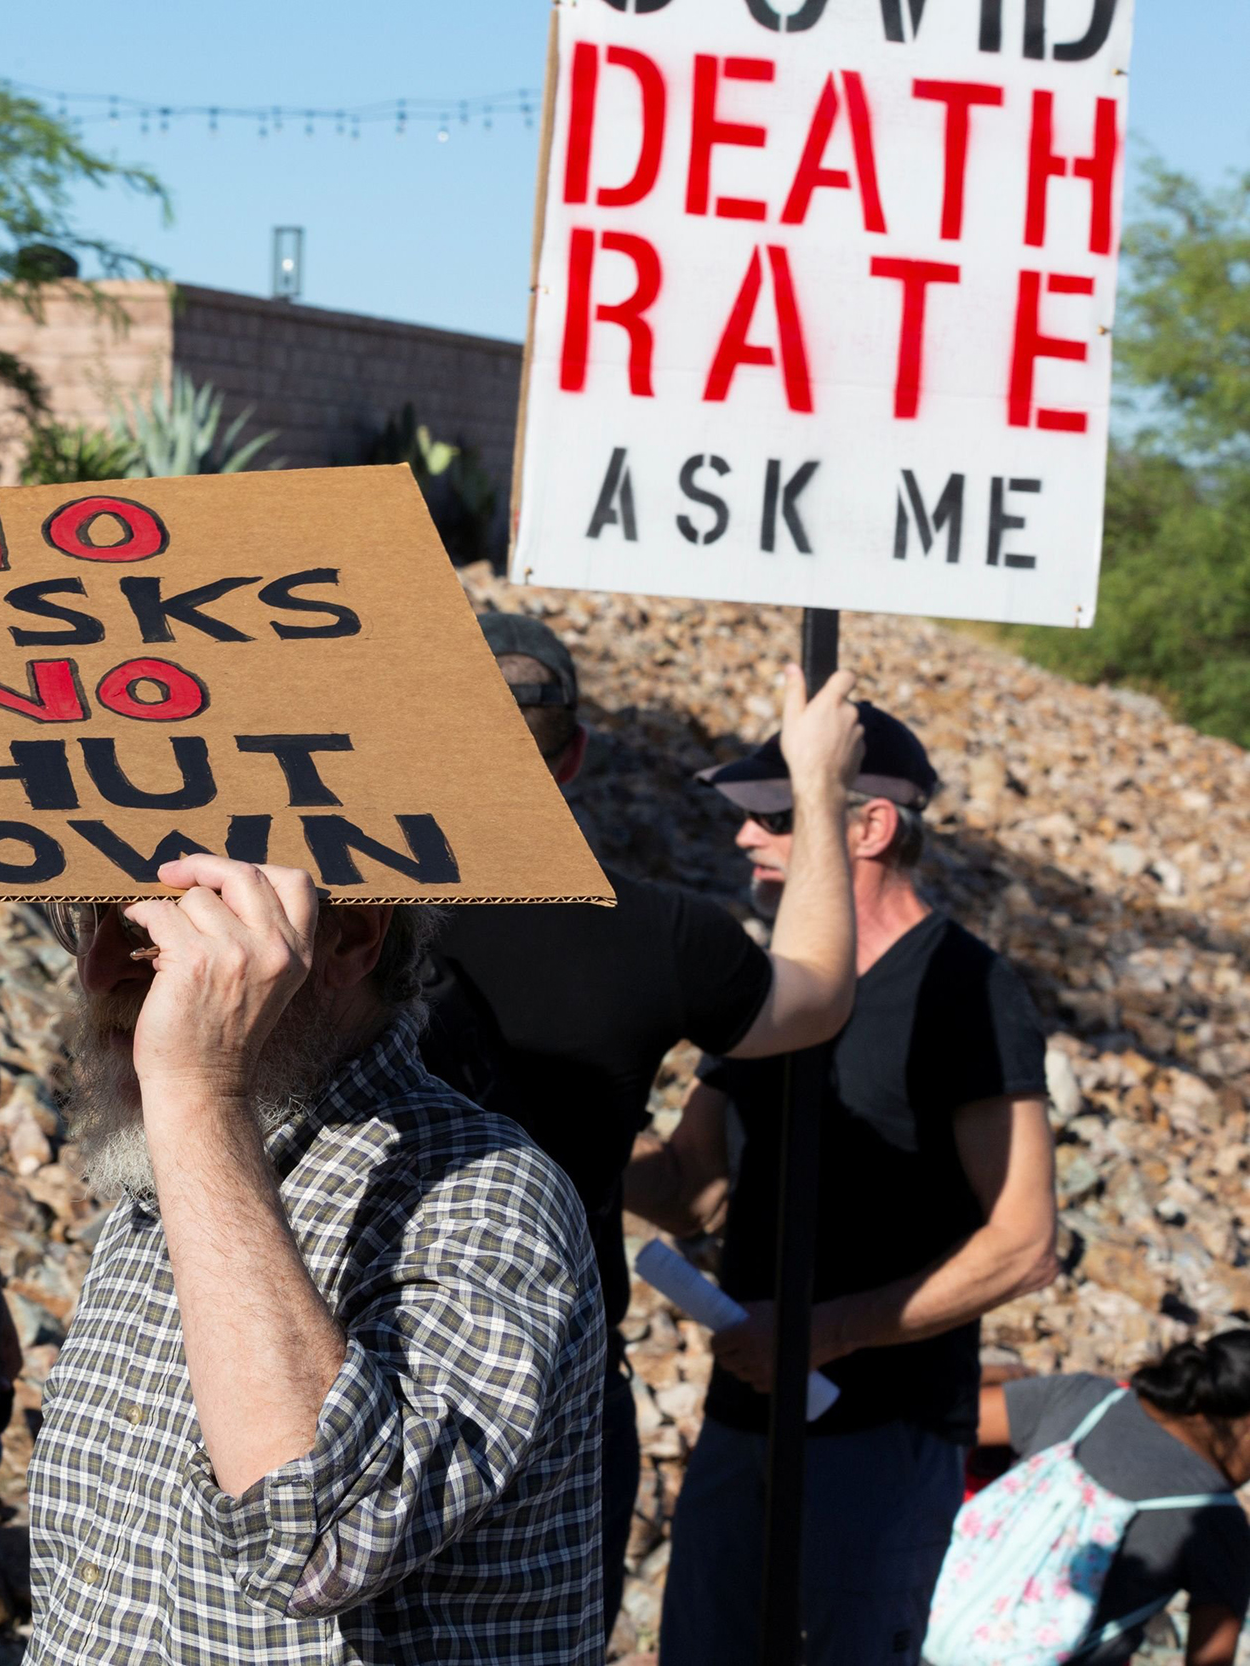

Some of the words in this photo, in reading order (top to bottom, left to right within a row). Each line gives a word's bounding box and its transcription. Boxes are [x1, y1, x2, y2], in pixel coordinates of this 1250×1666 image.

[561, 40, 1122, 258] DEATH
[558, 226, 1097, 435] RATE
[584, 446, 821, 555] ASK
[892, 468, 1043, 571] ME
